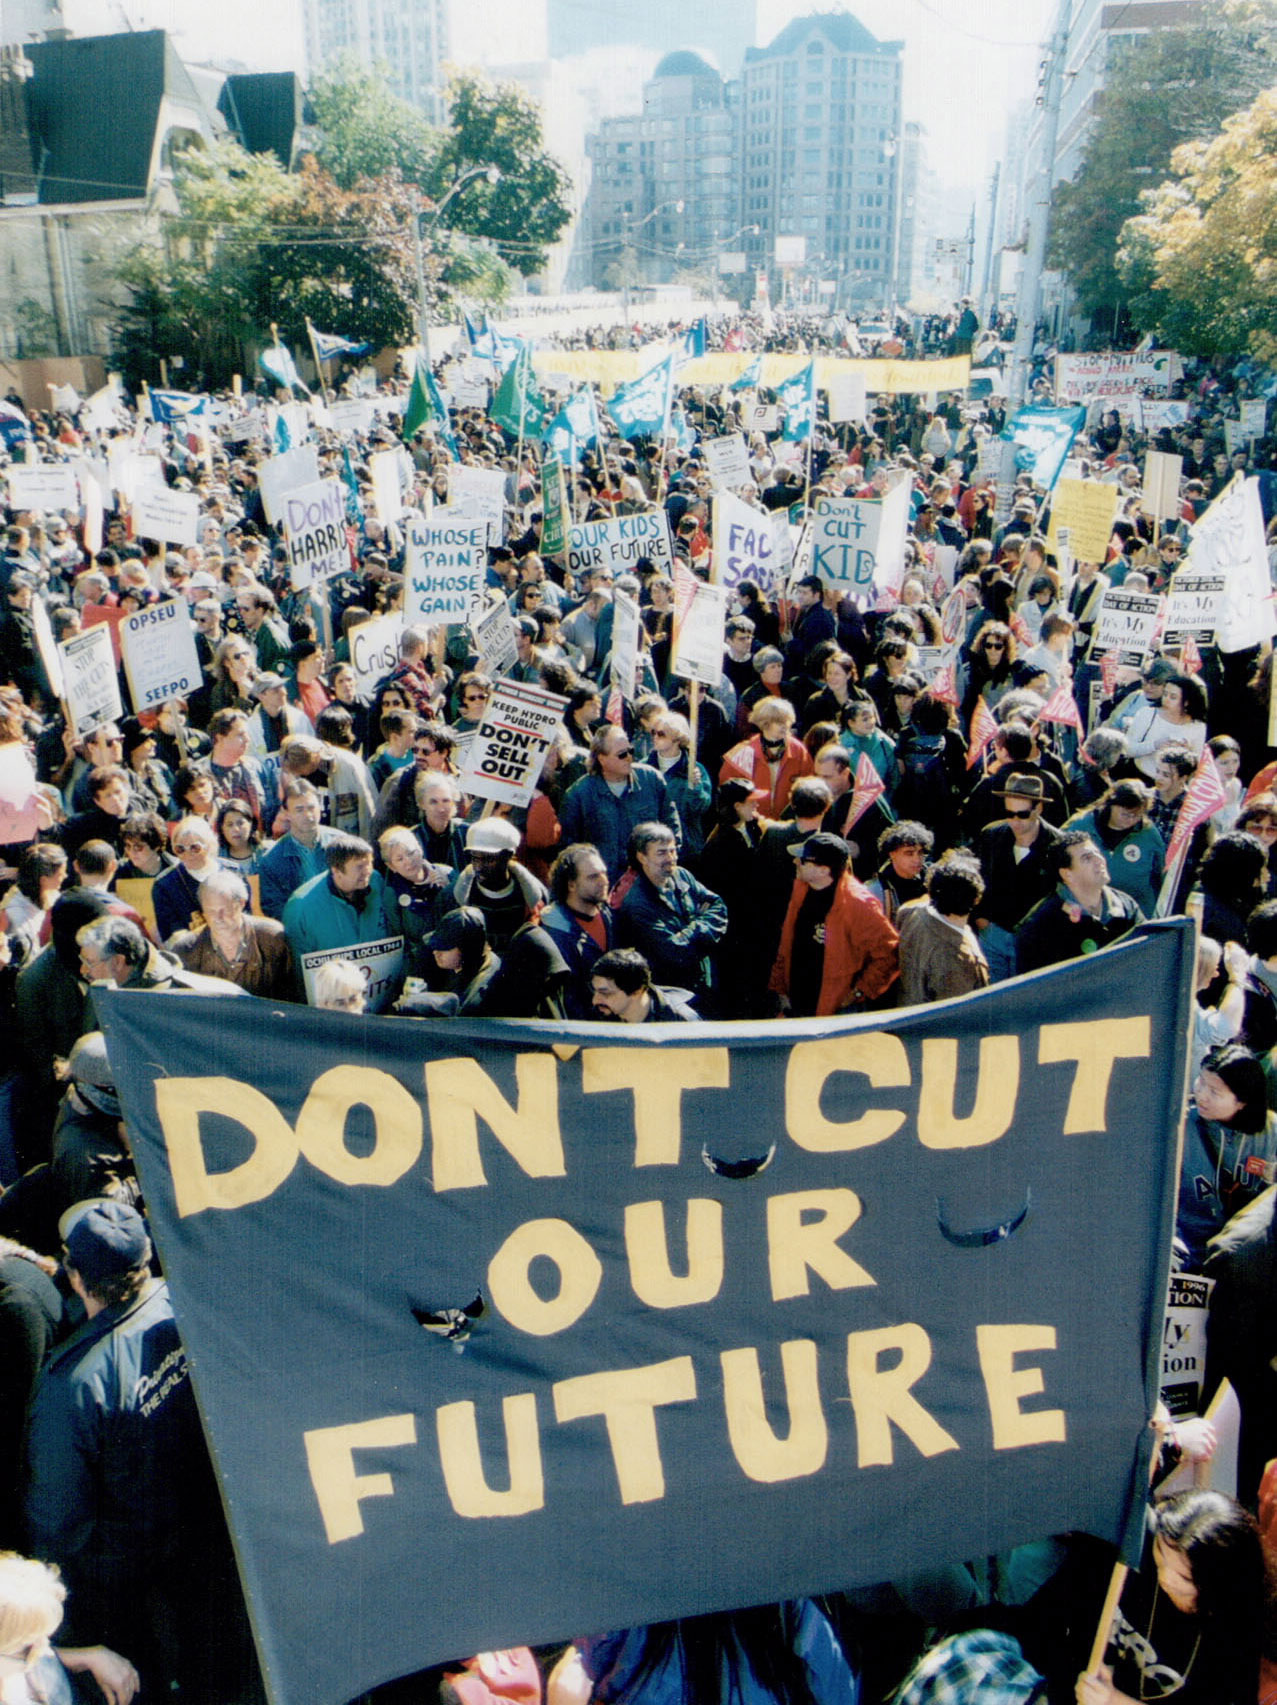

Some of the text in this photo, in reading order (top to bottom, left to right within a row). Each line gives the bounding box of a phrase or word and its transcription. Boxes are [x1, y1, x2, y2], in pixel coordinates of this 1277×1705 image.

[817, 501, 861, 521] Don't
[411, 527, 483, 547] WHOSE
[568, 515, 660, 548] OUR KIDS
[823, 519, 867, 540] CUT
[290, 519, 348, 565] HARRIS
[568, 538, 667, 570] OUR FUTURE
[311, 551, 344, 578] ME!
[420, 549, 485, 570] PAIN?
[412, 574, 481, 593] WHOSE
[419, 592, 482, 615] GAIN?
[129, 604, 175, 631] OPSEU
[1103, 616, 1118, 628] It's
[1168, 613, 1216, 625] Education
[1095, 631, 1147, 647] Education
[145, 677, 189, 703] SEFPO
[491, 700, 557, 726] KEEP HYDRO
[503, 713, 540, 731] PUBLIC
[479, 723, 550, 753] DON'T
[485, 743, 530, 767] SELL
[481, 759, 526, 781] OUT
[1183, 796, 1213, 822] AUX
[355, 946, 382, 958] LOCAL
[155, 1015, 1151, 1217] DON'T CUT
[487, 1188, 875, 1337] OUR
[1182, 1281, 1206, 1292] 1996
[140, 1392, 161, 1417] THE
[303, 1323, 1066, 1545] FUTURE
